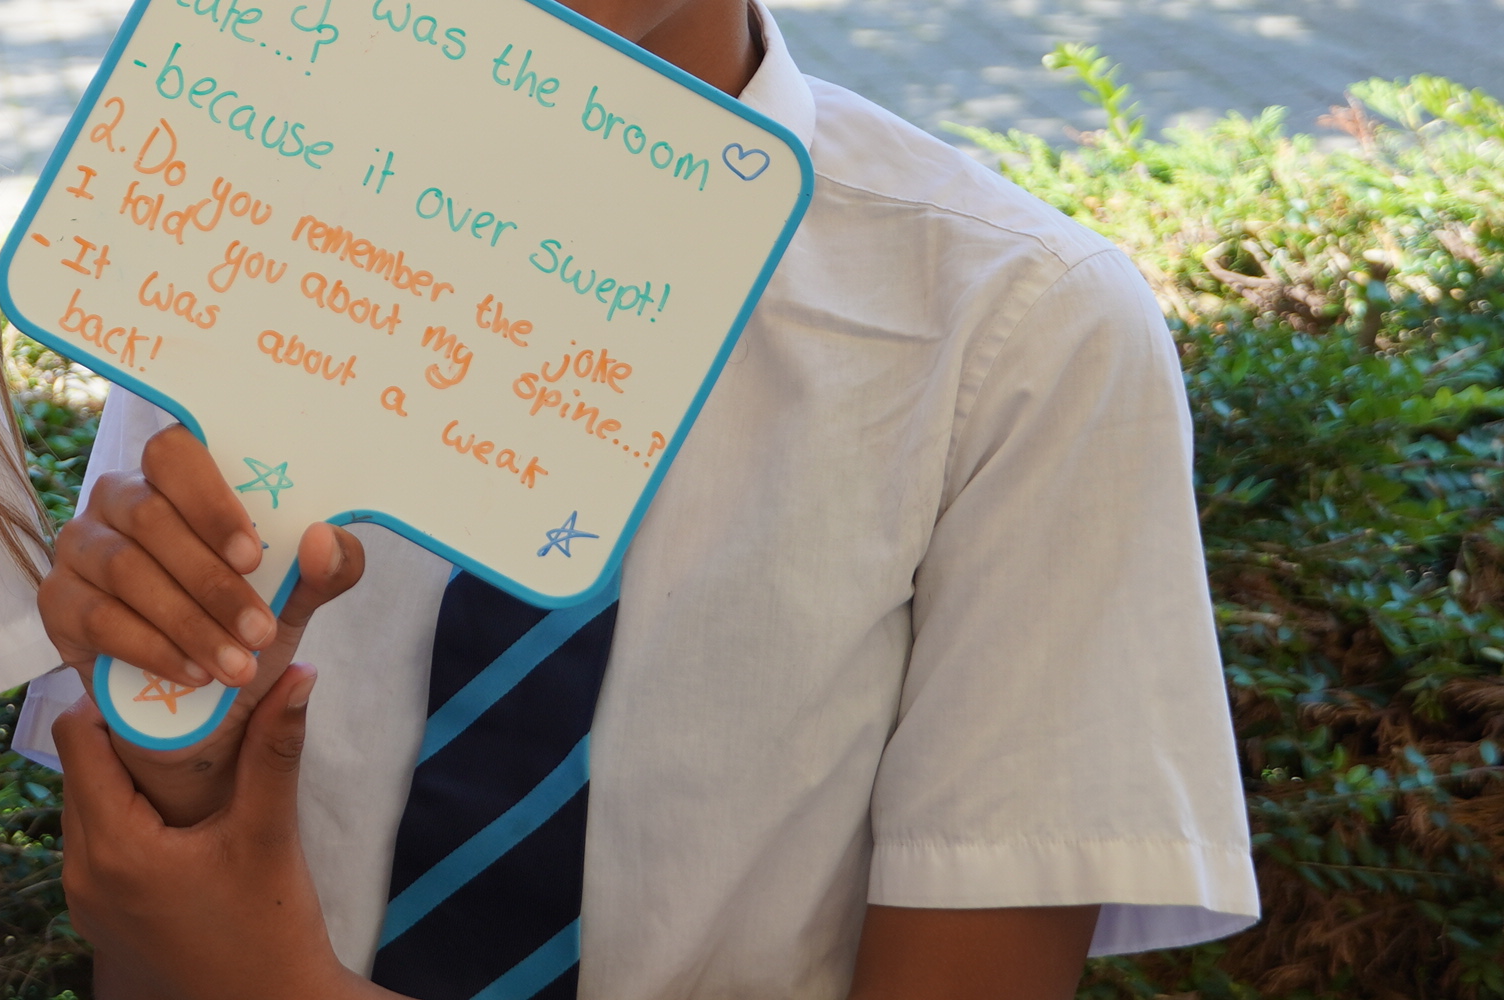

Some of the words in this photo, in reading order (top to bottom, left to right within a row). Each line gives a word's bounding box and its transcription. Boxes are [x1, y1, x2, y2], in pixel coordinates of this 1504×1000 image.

[361, 146, 397, 195] it
[413, 185, 519, 249] over
[490, 42, 562, 109] the
[580, 84, 711, 193] broom
[57, 287, 165, 373] back!
[64, 163, 98, 201] I
[206, 238, 289, 294] you
[299, 271, 402, 336] about
[420, 324, 474, 390] my
[132, 116, 188, 187] Do
[190, 175, 274, 233] you
[291, 213, 457, 303] remember
[475, 292, 534, 348] the
[540, 338, 634, 394] joke
[137, 270, 222, 330] was
[256, 328, 358, 386] about
[379, 384, 409, 418] a
[440, 418, 550, 489] weak
